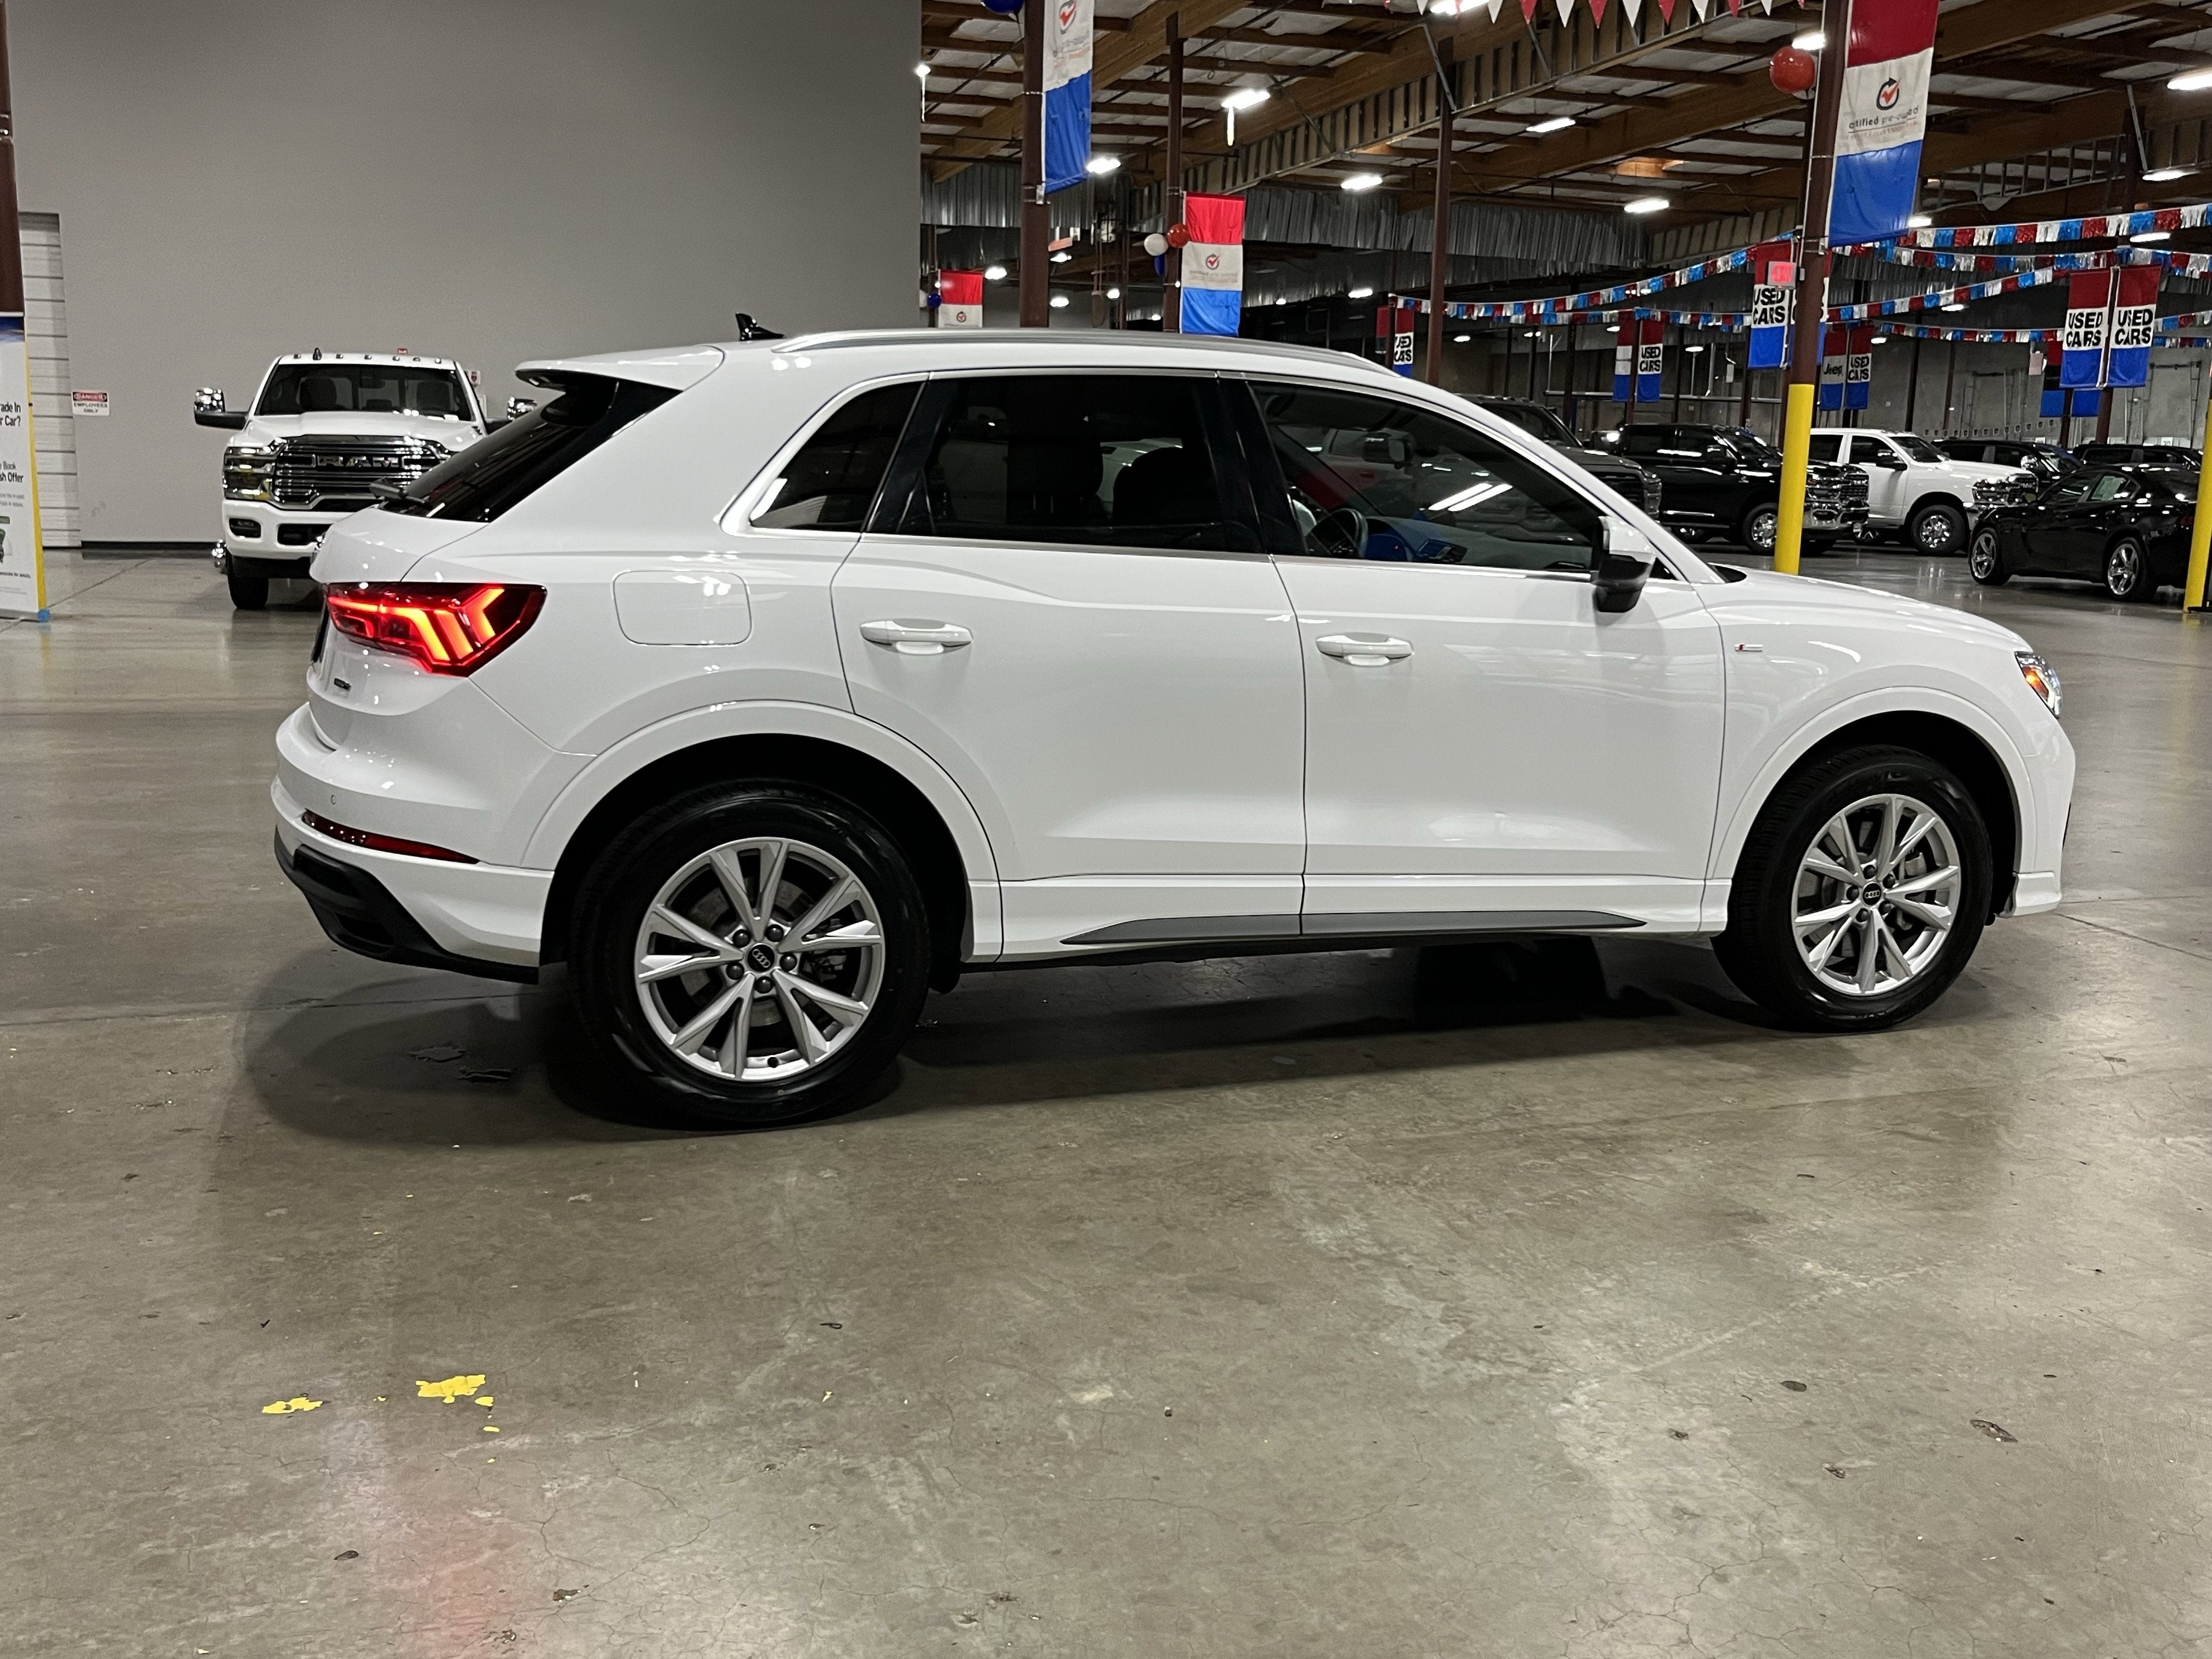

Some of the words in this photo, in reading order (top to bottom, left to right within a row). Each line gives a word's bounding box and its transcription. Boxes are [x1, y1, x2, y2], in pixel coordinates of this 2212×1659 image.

[2069, 312, 2103, 329] USED
[2118, 309, 2153, 326] USED
[2066, 330, 2101, 347] CARS
[2115, 327, 2151, 345] CARS
[5, 415, 21, 426] Car?
[318, 455, 399, 467] RAM
